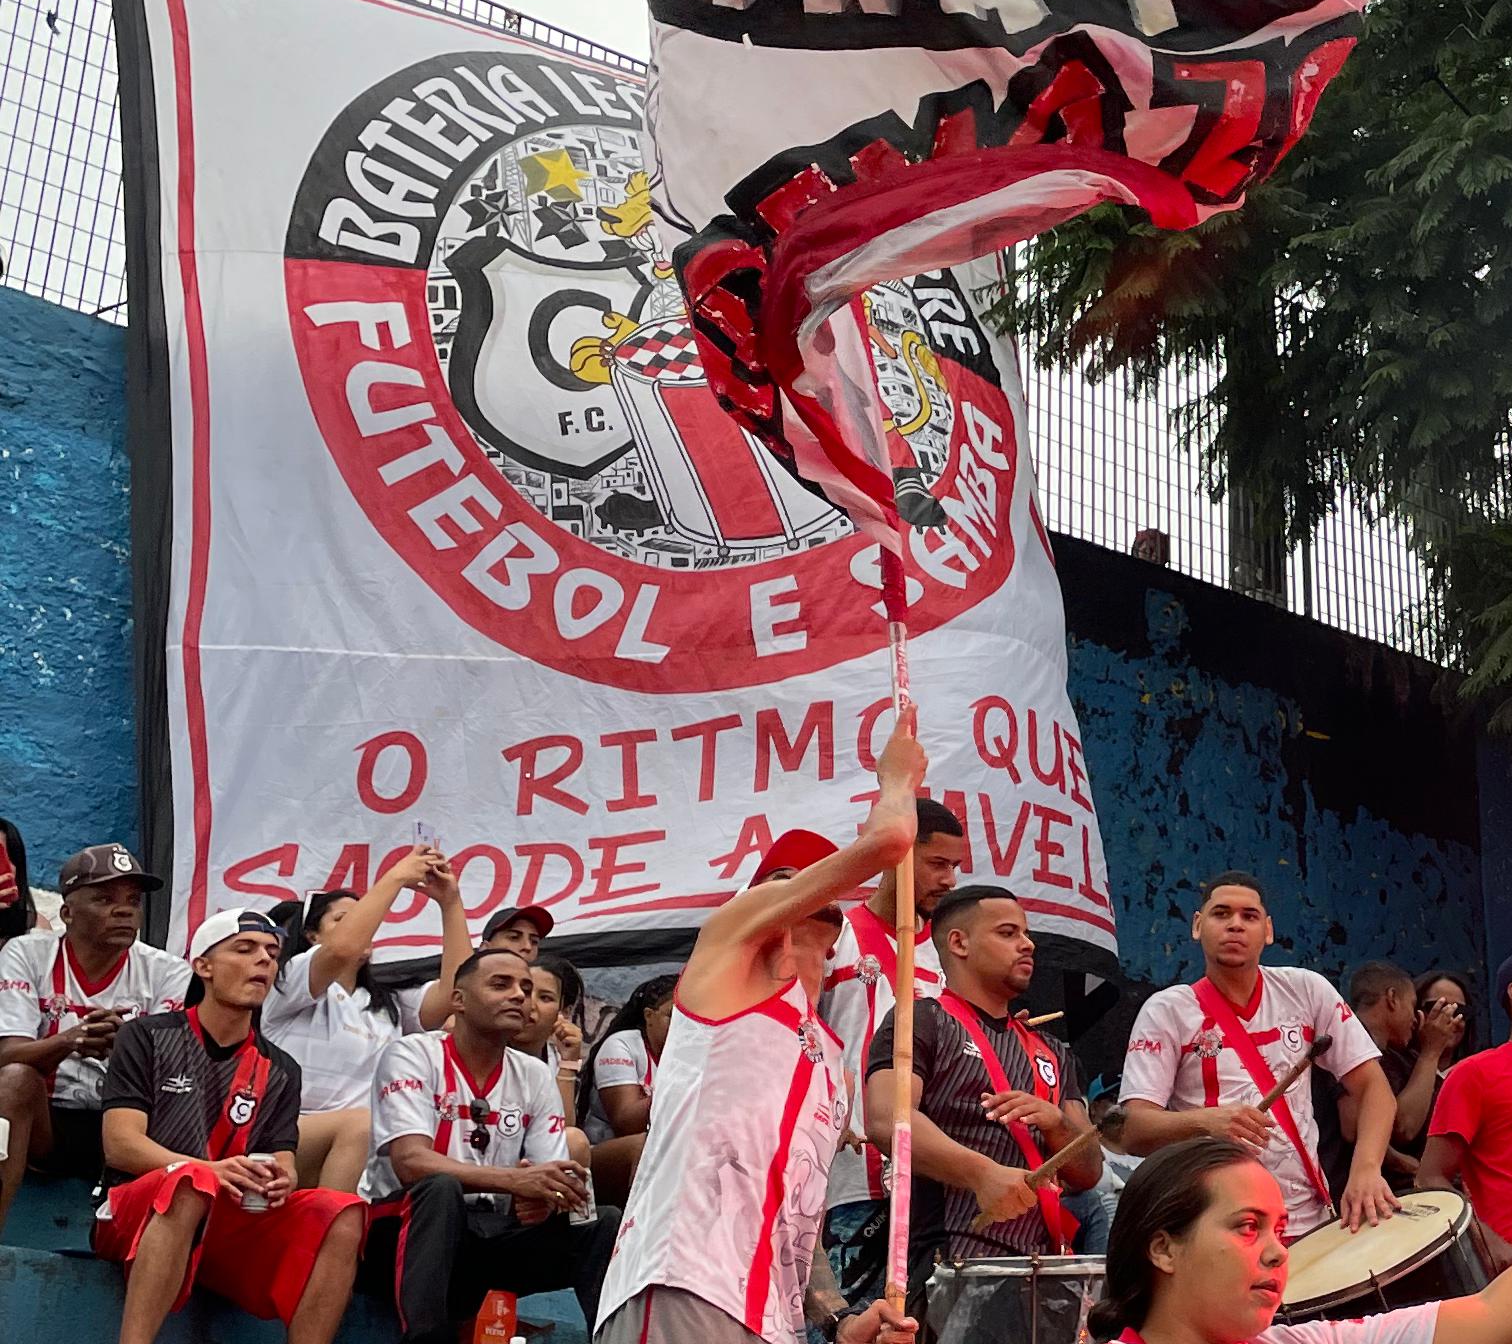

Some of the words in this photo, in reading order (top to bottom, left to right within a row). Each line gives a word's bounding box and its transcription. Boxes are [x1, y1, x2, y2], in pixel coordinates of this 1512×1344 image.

[318, 64, 559, 264] BATERIA
[303, 301, 670, 664] FUTEBOL
[749, 576, 809, 657] E
[849, 400, 1010, 620] SAMBA
[353, 729, 428, 814] O
[968, 695, 1094, 813] QUE
